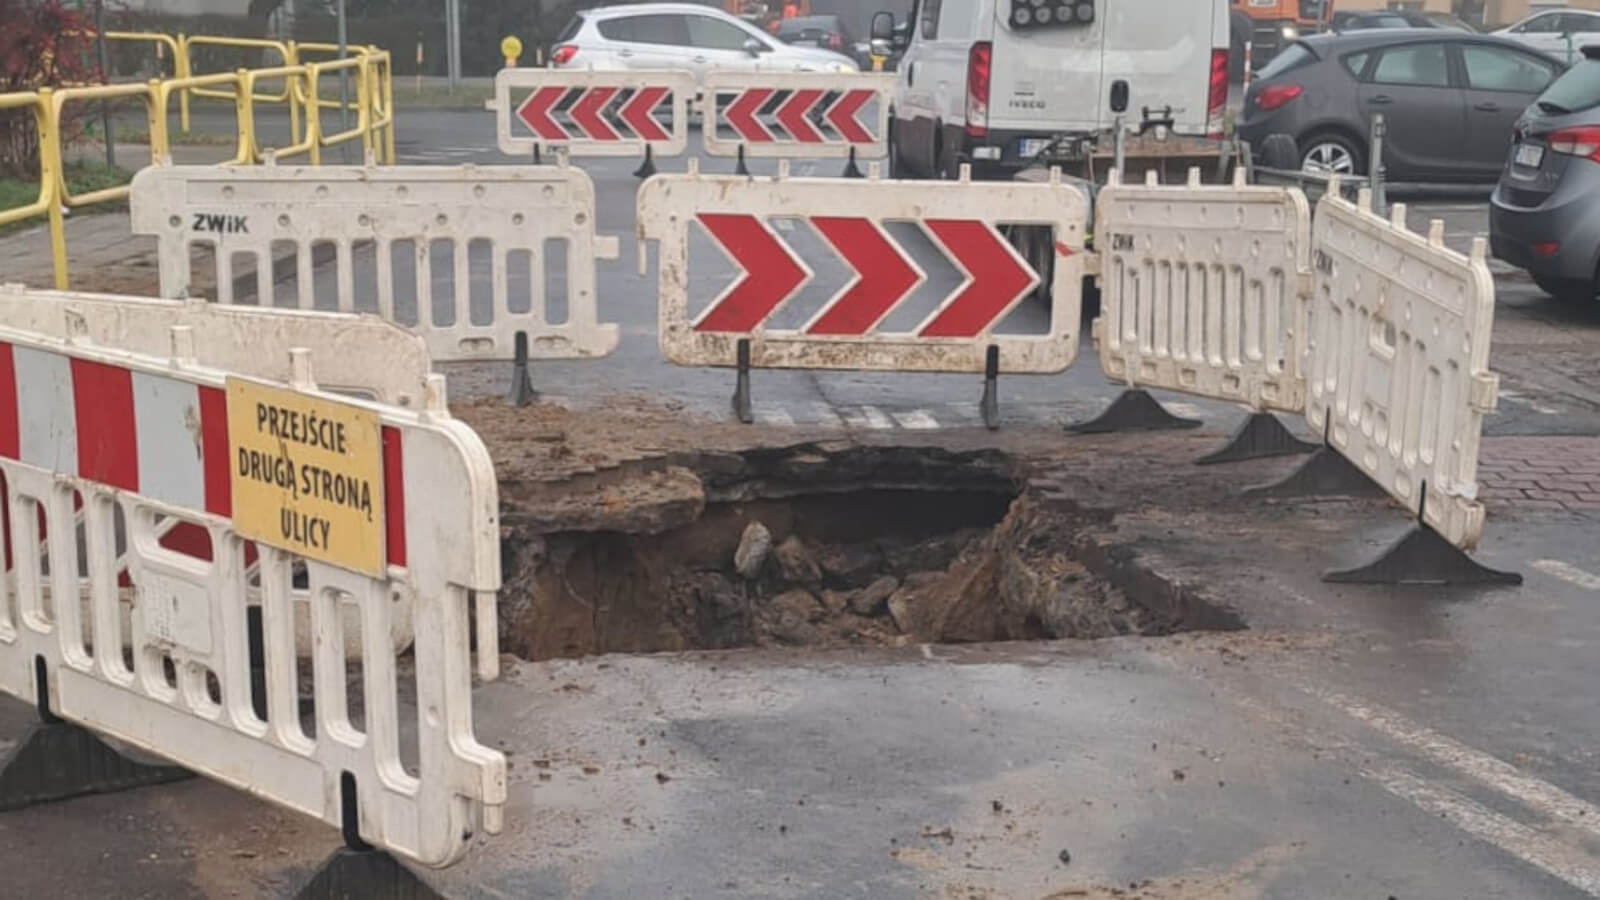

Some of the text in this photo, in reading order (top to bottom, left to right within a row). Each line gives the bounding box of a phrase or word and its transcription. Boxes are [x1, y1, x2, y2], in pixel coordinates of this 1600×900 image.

[192, 213, 249, 233] ZWiK
[257, 402, 346, 454] PRZEJŚCIE
[238, 446, 372, 523] DRUGĄ STRONĄ
[280, 507, 330, 550] ULICY
